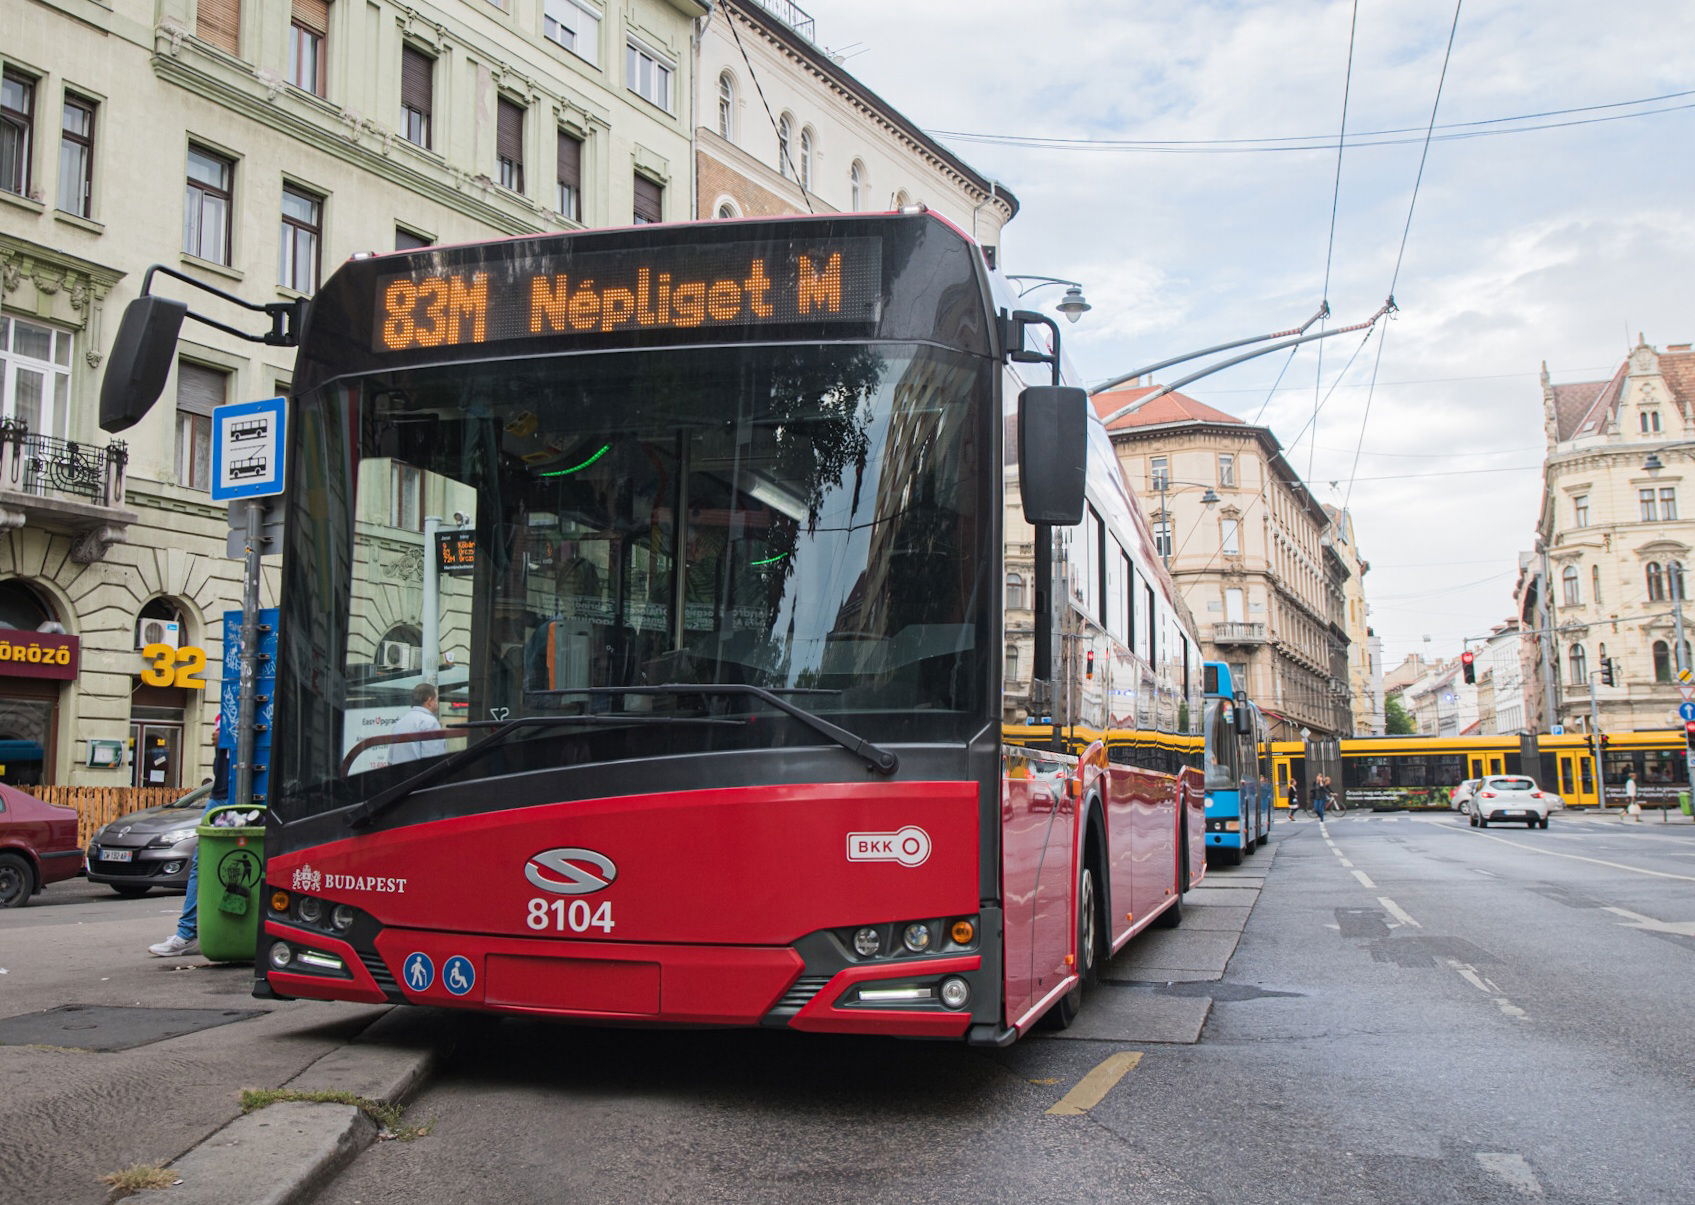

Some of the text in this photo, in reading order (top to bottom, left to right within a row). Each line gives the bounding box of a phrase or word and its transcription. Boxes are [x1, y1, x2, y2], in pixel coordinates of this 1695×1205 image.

[383, 252, 842, 349] 83M Népliget M
[141, 643, 207, 689] 32
[858, 840, 893, 853] BKK
[324, 873, 407, 893] BUDAPEST
[526, 897, 615, 934] 8104
